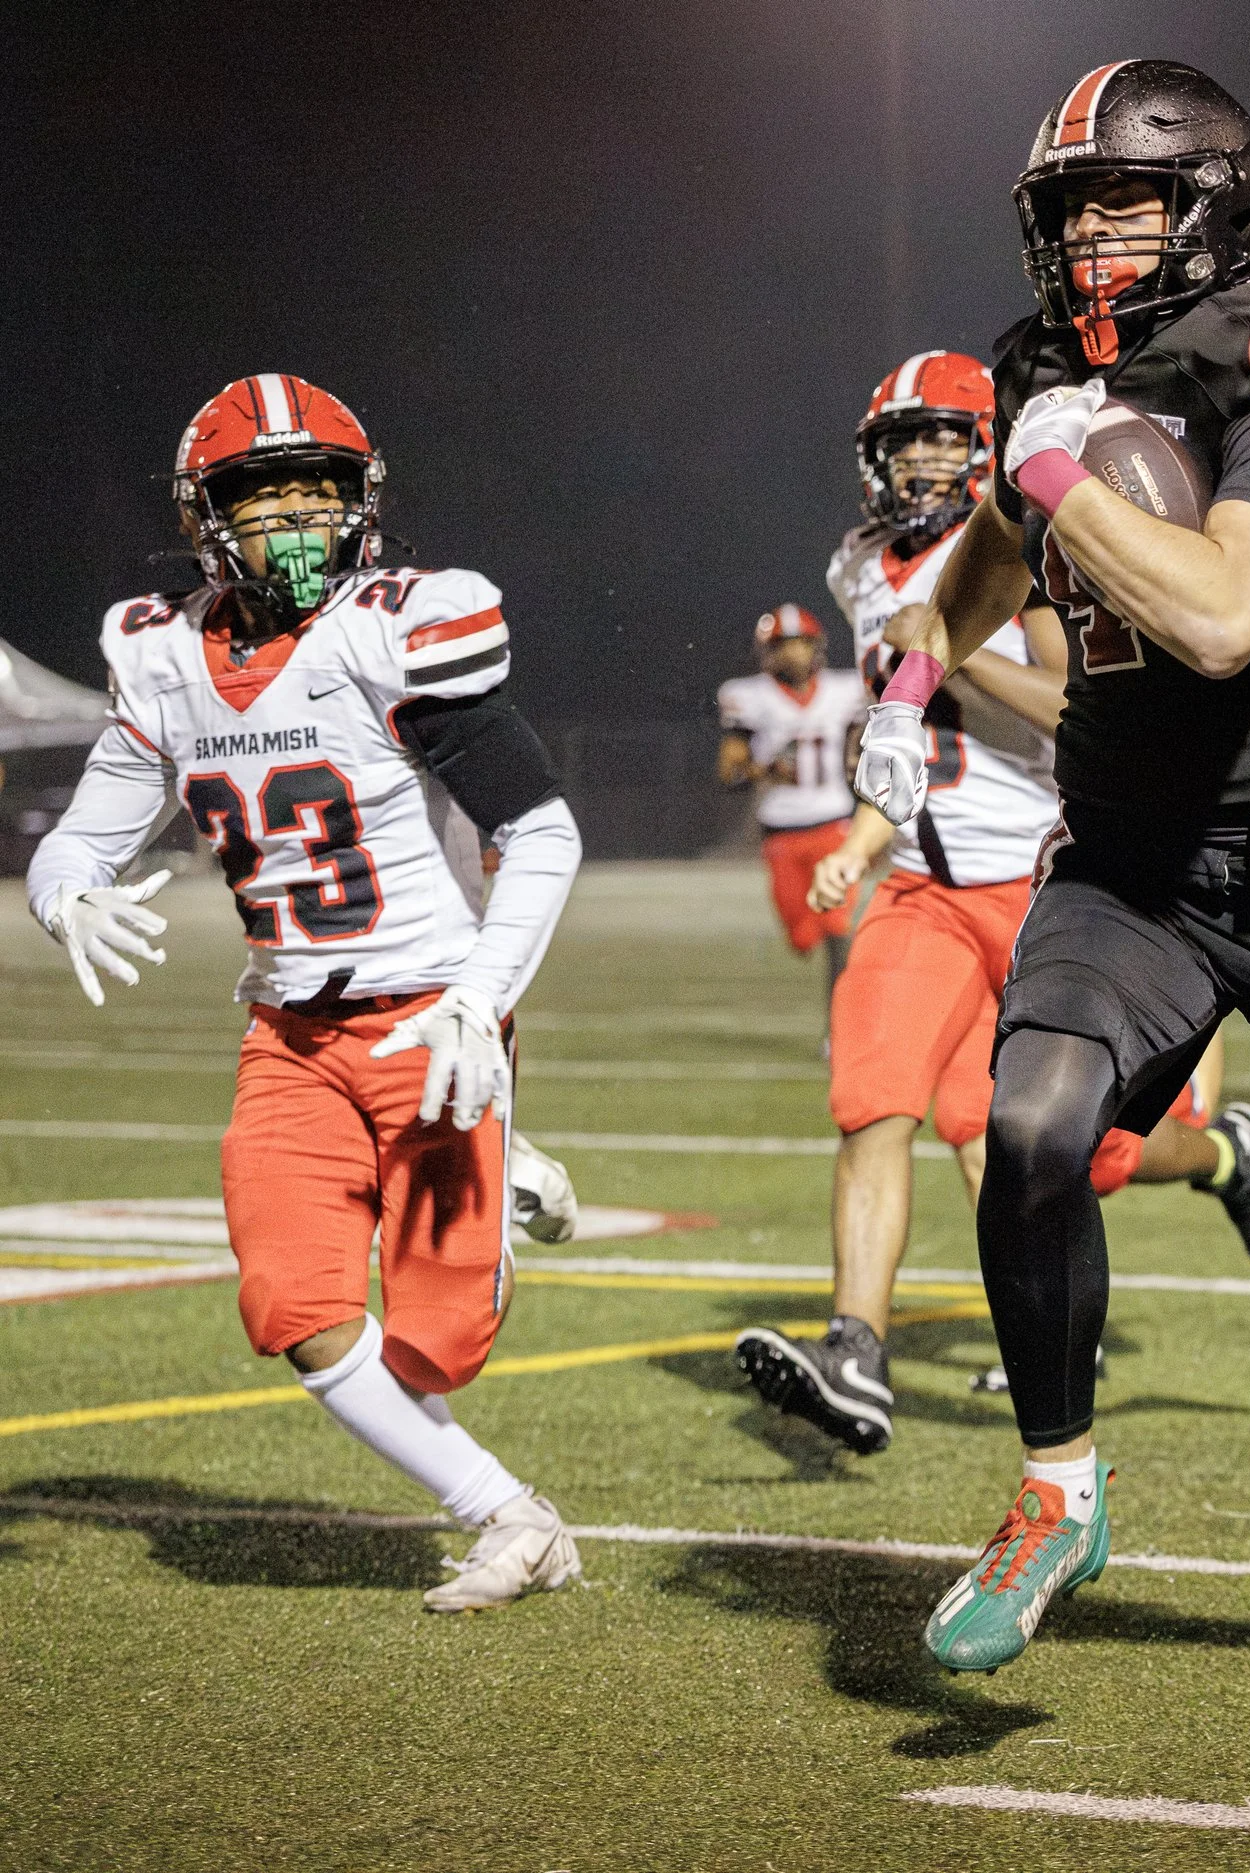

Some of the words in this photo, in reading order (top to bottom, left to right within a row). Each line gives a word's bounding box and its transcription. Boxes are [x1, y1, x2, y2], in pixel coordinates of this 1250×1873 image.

[1045, 142, 1097, 162] Riddell
[254, 431, 311, 447] Riddell
[1131, 452, 1168, 516] OMEGA
[195, 726, 319, 761] SAMMAMISH
[184, 759, 385, 948] 23
